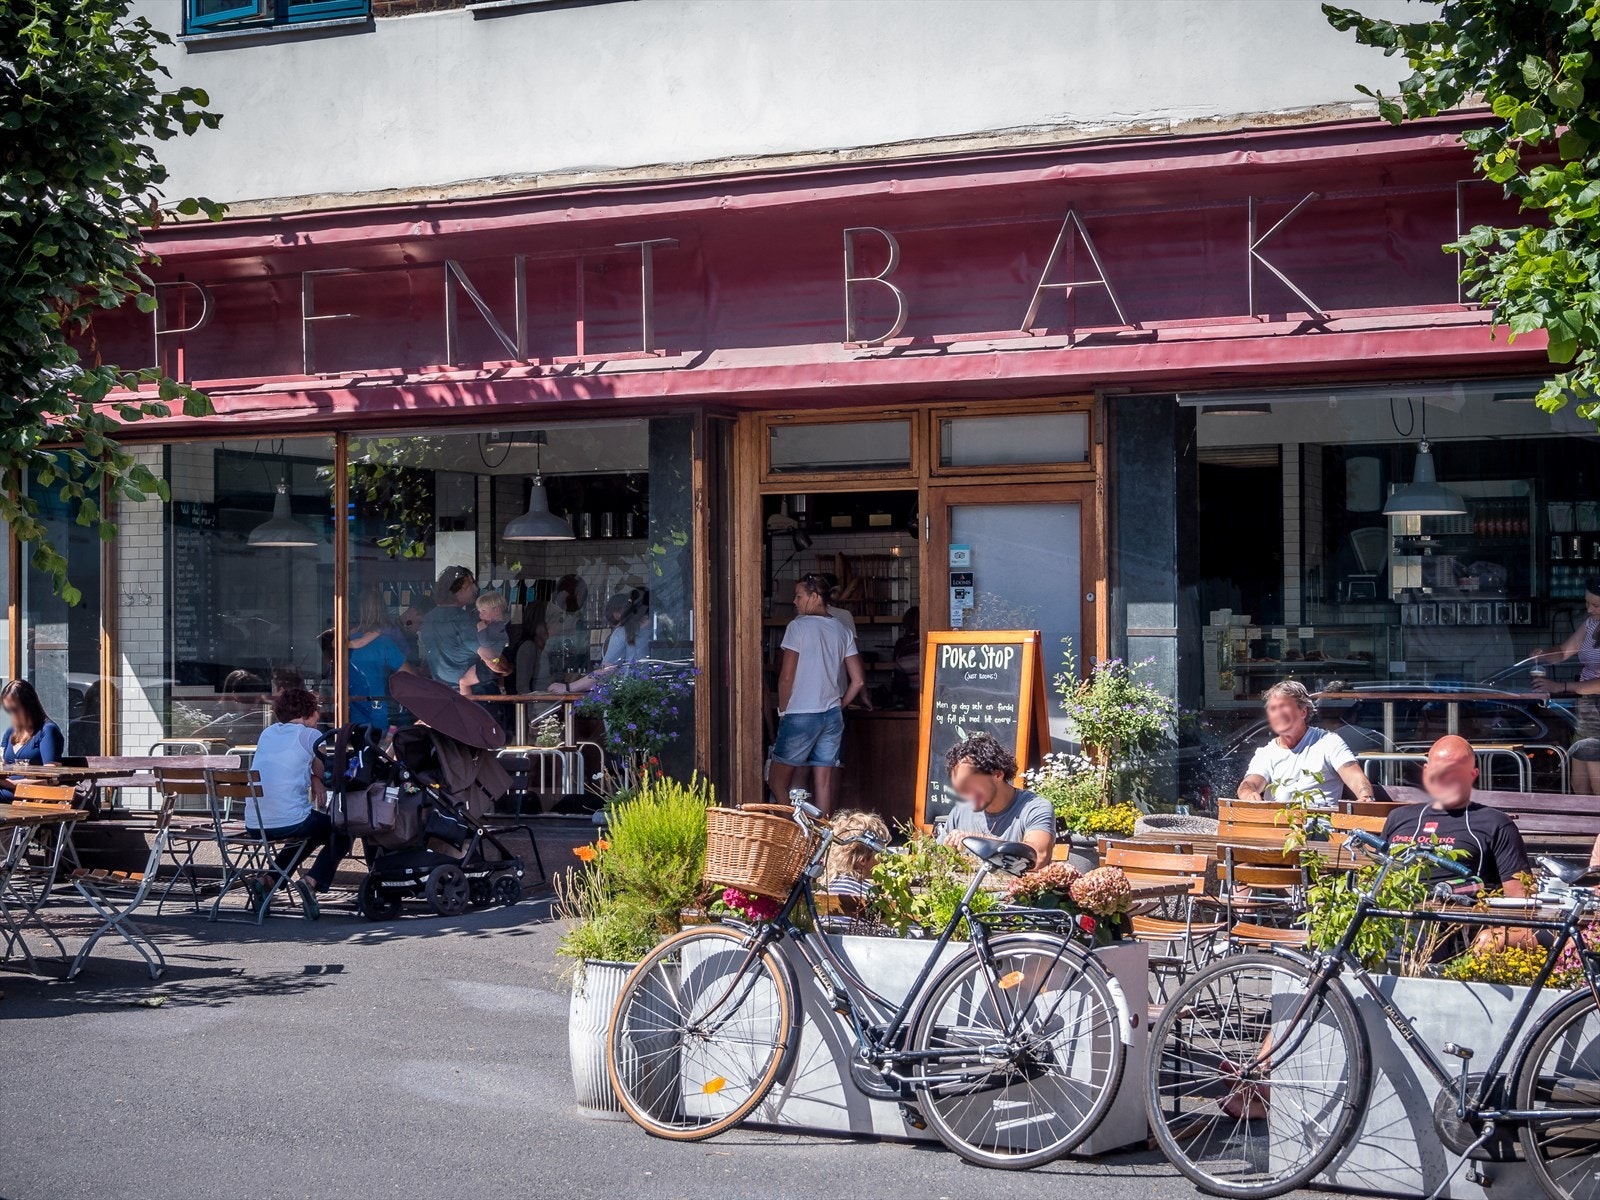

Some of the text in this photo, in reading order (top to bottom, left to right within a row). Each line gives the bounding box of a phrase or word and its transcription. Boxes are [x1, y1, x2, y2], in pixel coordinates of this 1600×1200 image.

[936, 701, 949, 709] Men
[959, 702, 970, 715] deg
[969, 715, 980, 723] med
[1383, 1004, 1414, 1041] RALEIGH
